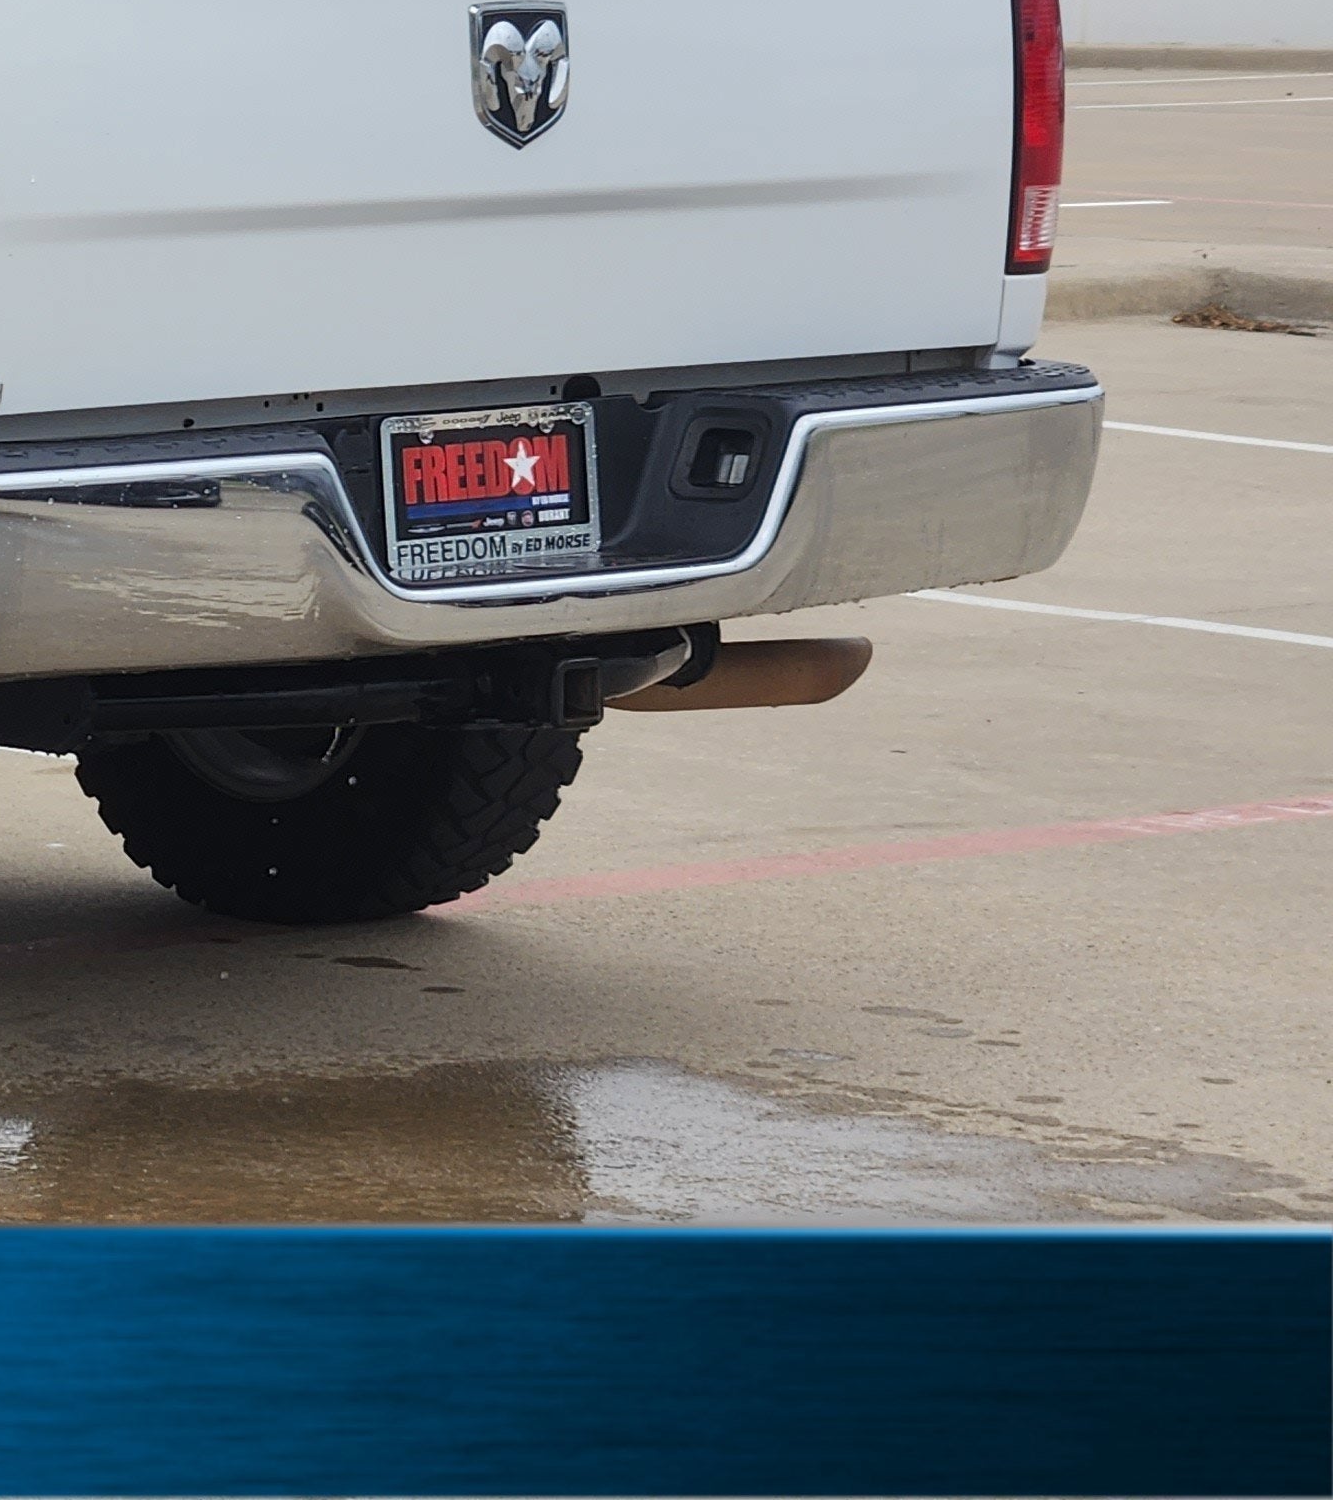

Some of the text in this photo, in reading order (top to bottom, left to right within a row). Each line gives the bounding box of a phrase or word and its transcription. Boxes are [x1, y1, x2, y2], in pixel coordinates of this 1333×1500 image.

[496, 411, 522, 424] Jeep
[402, 434, 570, 505] FREEDOM
[397, 535, 508, 567] FREEDOM
[525, 537, 542, 552] ED
[544, 533, 591, 550] MORSE
